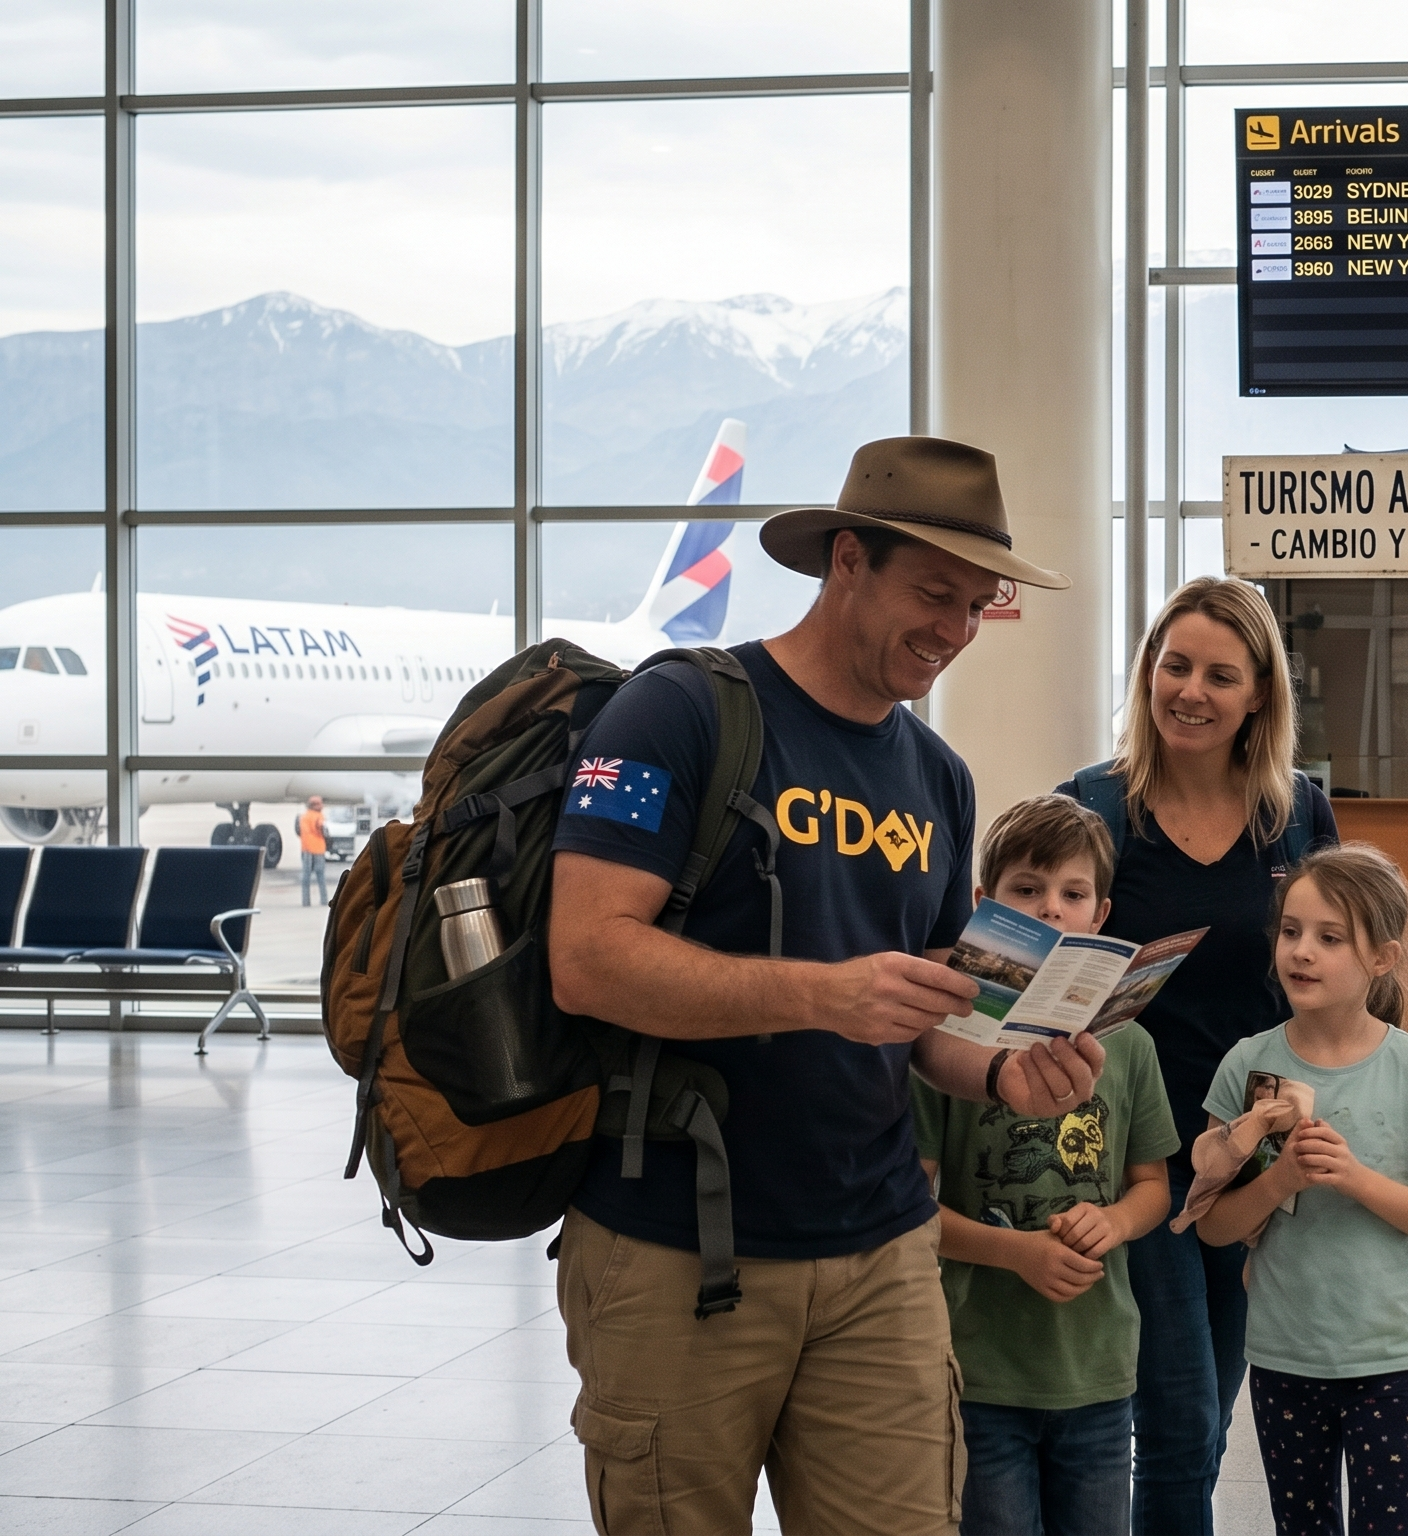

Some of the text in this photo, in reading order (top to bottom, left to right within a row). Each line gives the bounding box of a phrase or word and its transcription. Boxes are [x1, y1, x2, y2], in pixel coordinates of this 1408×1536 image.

[1290, 117, 1400, 144] Arrivals
[1293, 184, 1333, 200] 3029
[1294, 209, 1333, 225] 3895
[1347, 233, 1394, 250] NEW
[1294, 261, 1334, 277] 3960
[1347, 259, 1394, 276] NEW
[1239, 469, 1375, 515] TURISMO
[1271, 528, 1376, 560] CAMBIO
[1388, 528, 1406, 559] Y
[217, 624, 363, 658] LATAM
[776, 787, 934, 873] G'DY
